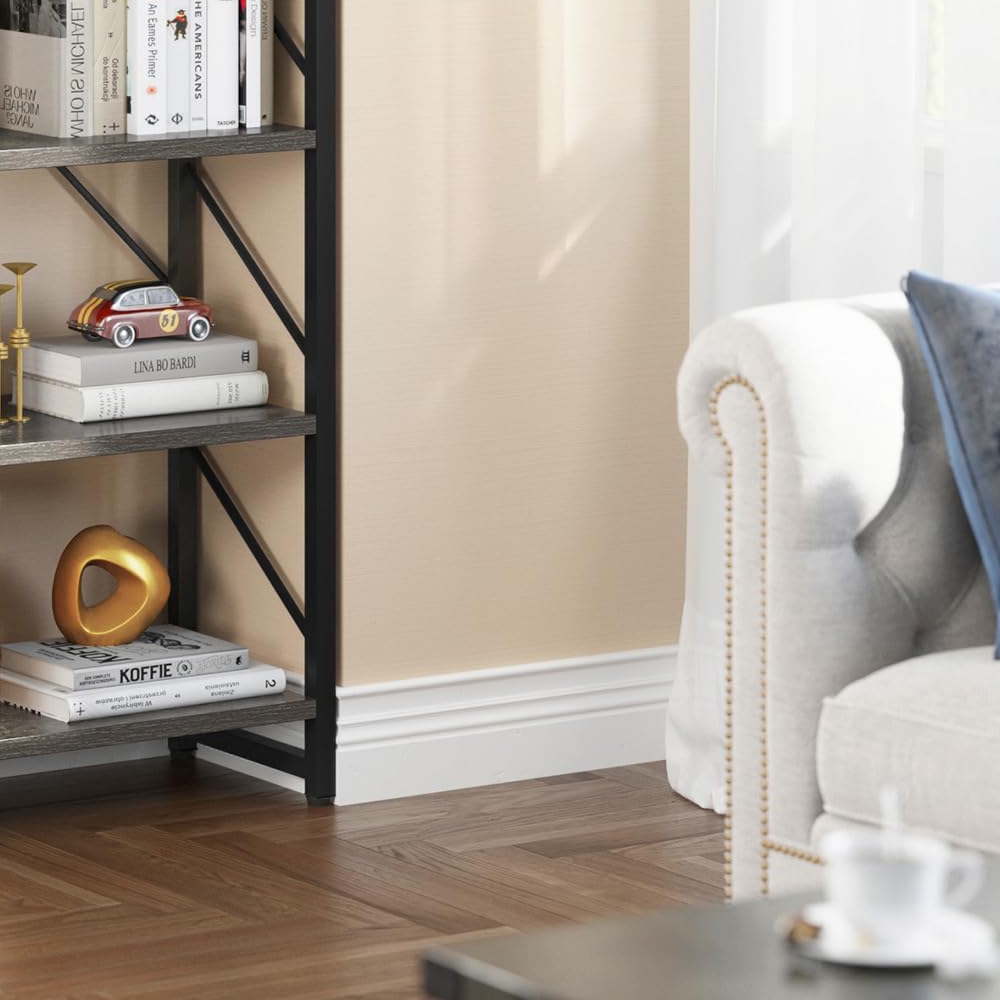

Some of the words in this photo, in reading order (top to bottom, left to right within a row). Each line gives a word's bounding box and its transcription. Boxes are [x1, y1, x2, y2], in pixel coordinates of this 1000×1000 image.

[148, 3, 158, 15] An
[147, 18, 158, 47] Eames
[147, 49, 158, 78] Primer
[194, 23, 202, 100] AMERICANS
[134, 359, 155, 374] LINA
[156, 359, 169, 372] BO
[170, 356, 197, 370] BARDI
[119, 662, 173, 685] KOFFIE
[265, 679, 276, 689] 2
